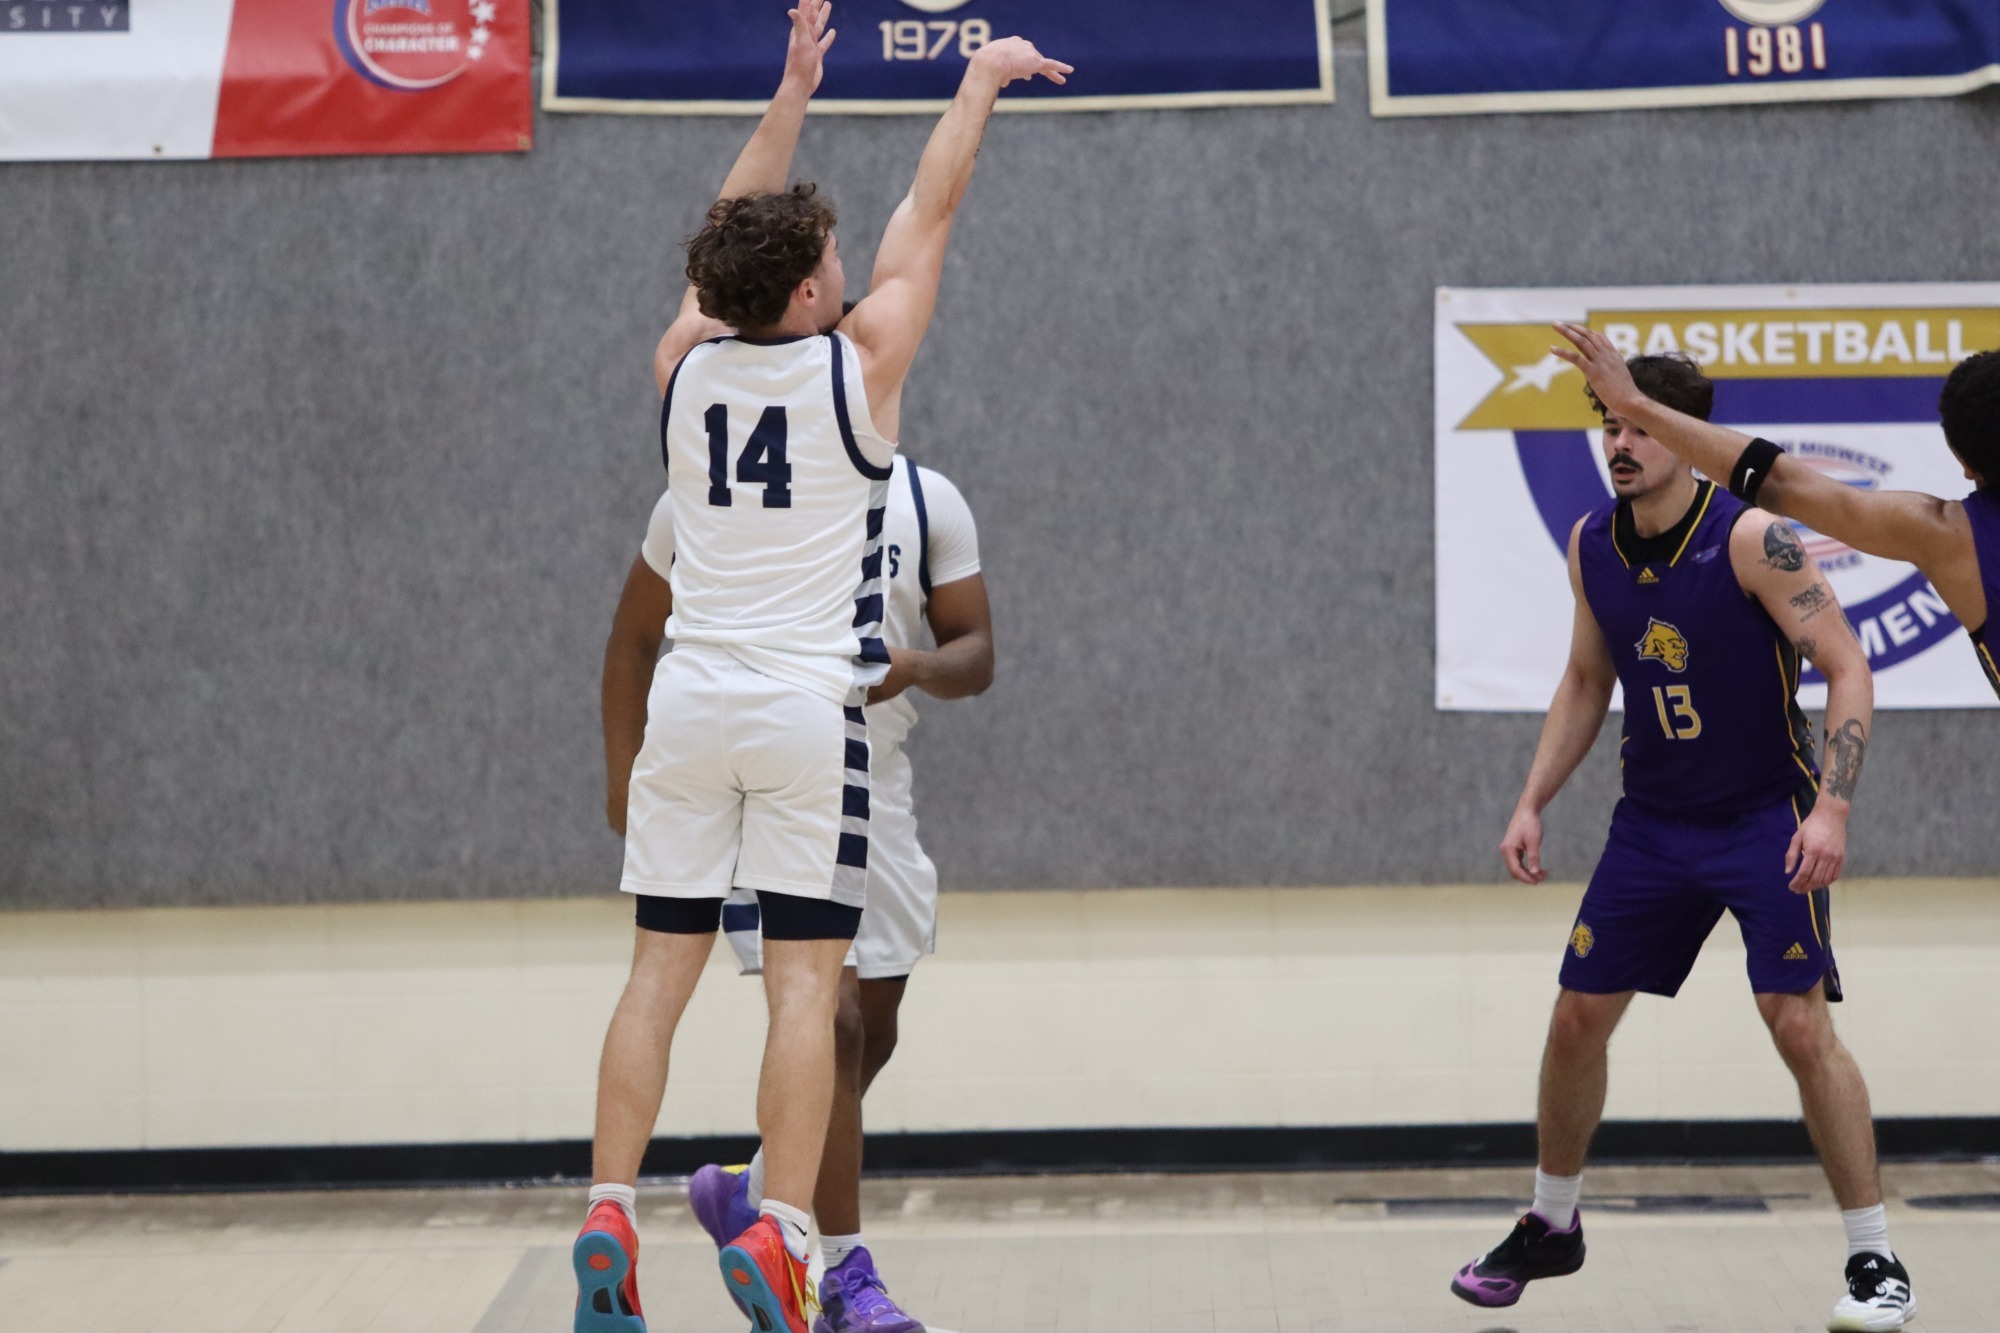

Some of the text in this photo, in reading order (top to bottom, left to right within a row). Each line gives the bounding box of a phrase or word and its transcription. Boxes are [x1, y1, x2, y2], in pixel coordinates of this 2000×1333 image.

[363, 36, 459, 53] CHARACTER
[878, 18, 991, 61] 1978
[1725, 22, 1827, 76] 1981
[1604, 320, 1978, 366] BASKETBALL
[704, 403, 792, 509] 14
[1799, 441, 1892, 475] MIDWEST
[1651, 684, 1702, 740] 13
